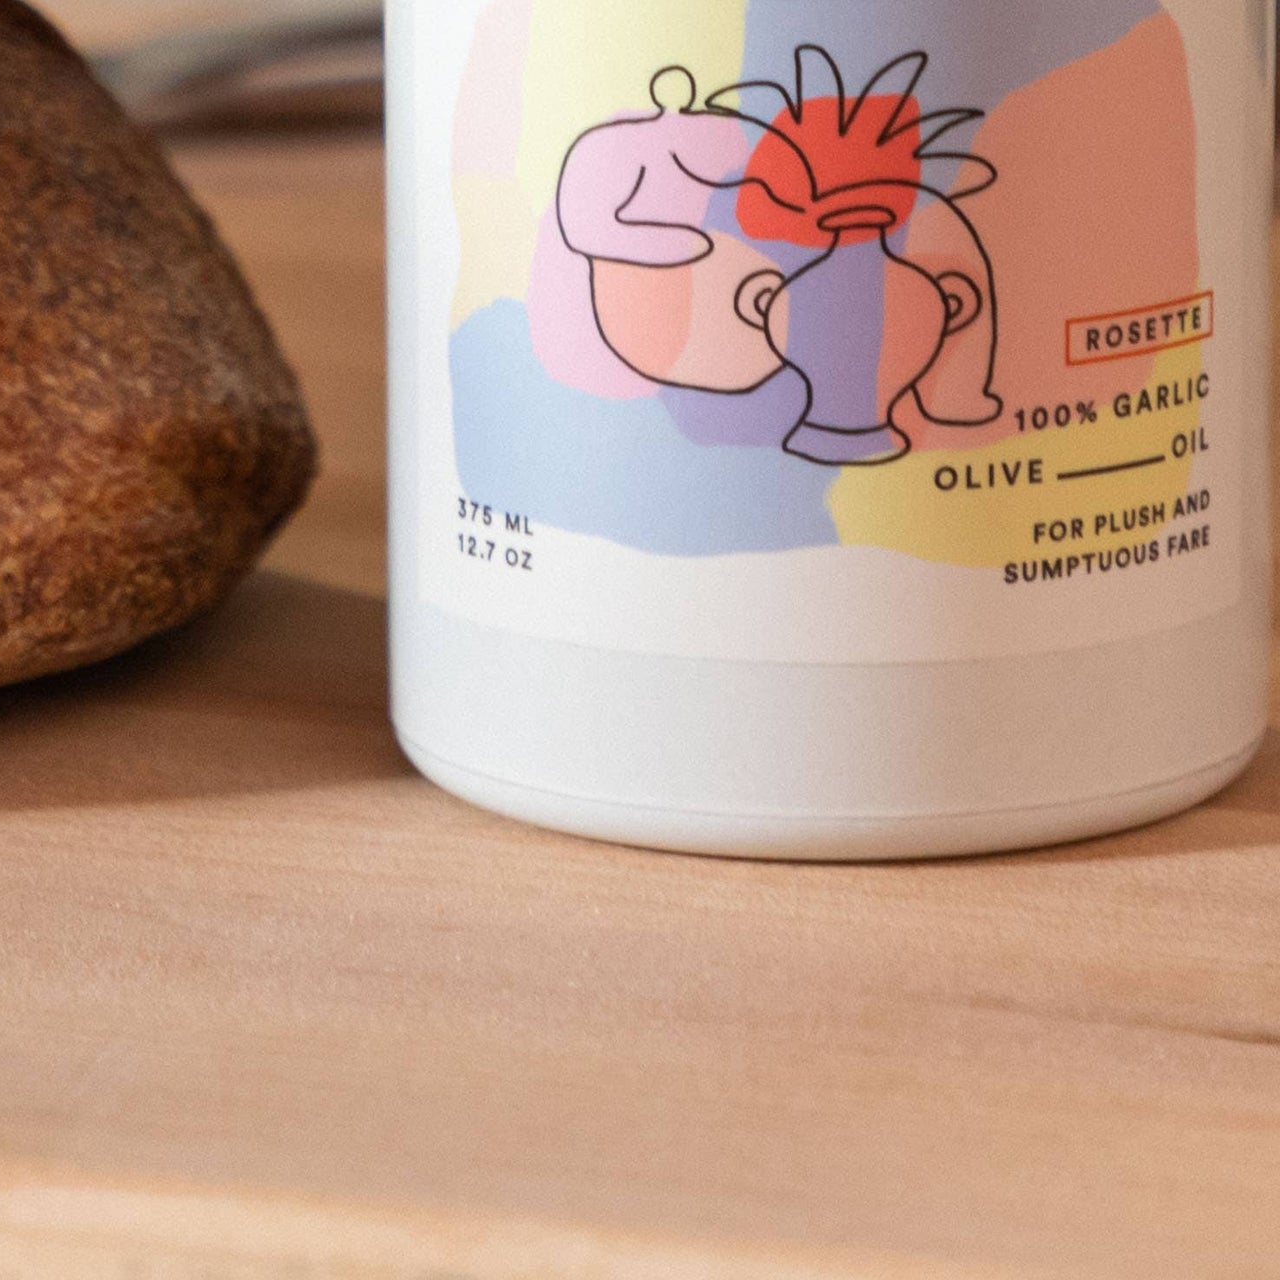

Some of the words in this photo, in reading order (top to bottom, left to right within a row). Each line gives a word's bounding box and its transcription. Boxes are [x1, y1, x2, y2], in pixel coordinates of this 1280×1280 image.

[1086, 306, 1202, 351] ROSETTE
[1014, 401, 1097, 432] 100%
[1113, 373, 1209, 419] GARLIC
[934, 459, 1044, 491] OLIVE
[1172, 427, 1209, 459] OIL
[458, 496, 493, 526] 375
[505, 511, 533, 536] ML
[1033, 518, 1084, 544] FOR
[1094, 502, 1165, 535] PLUSH
[1173, 489, 1210, 518] AND
[458, 533, 495, 561] 12.7
[505, 547, 532, 570] OZ
[1004, 540, 1159, 584] SUMPTUOUS
[1168, 525, 1210, 557] FARE
